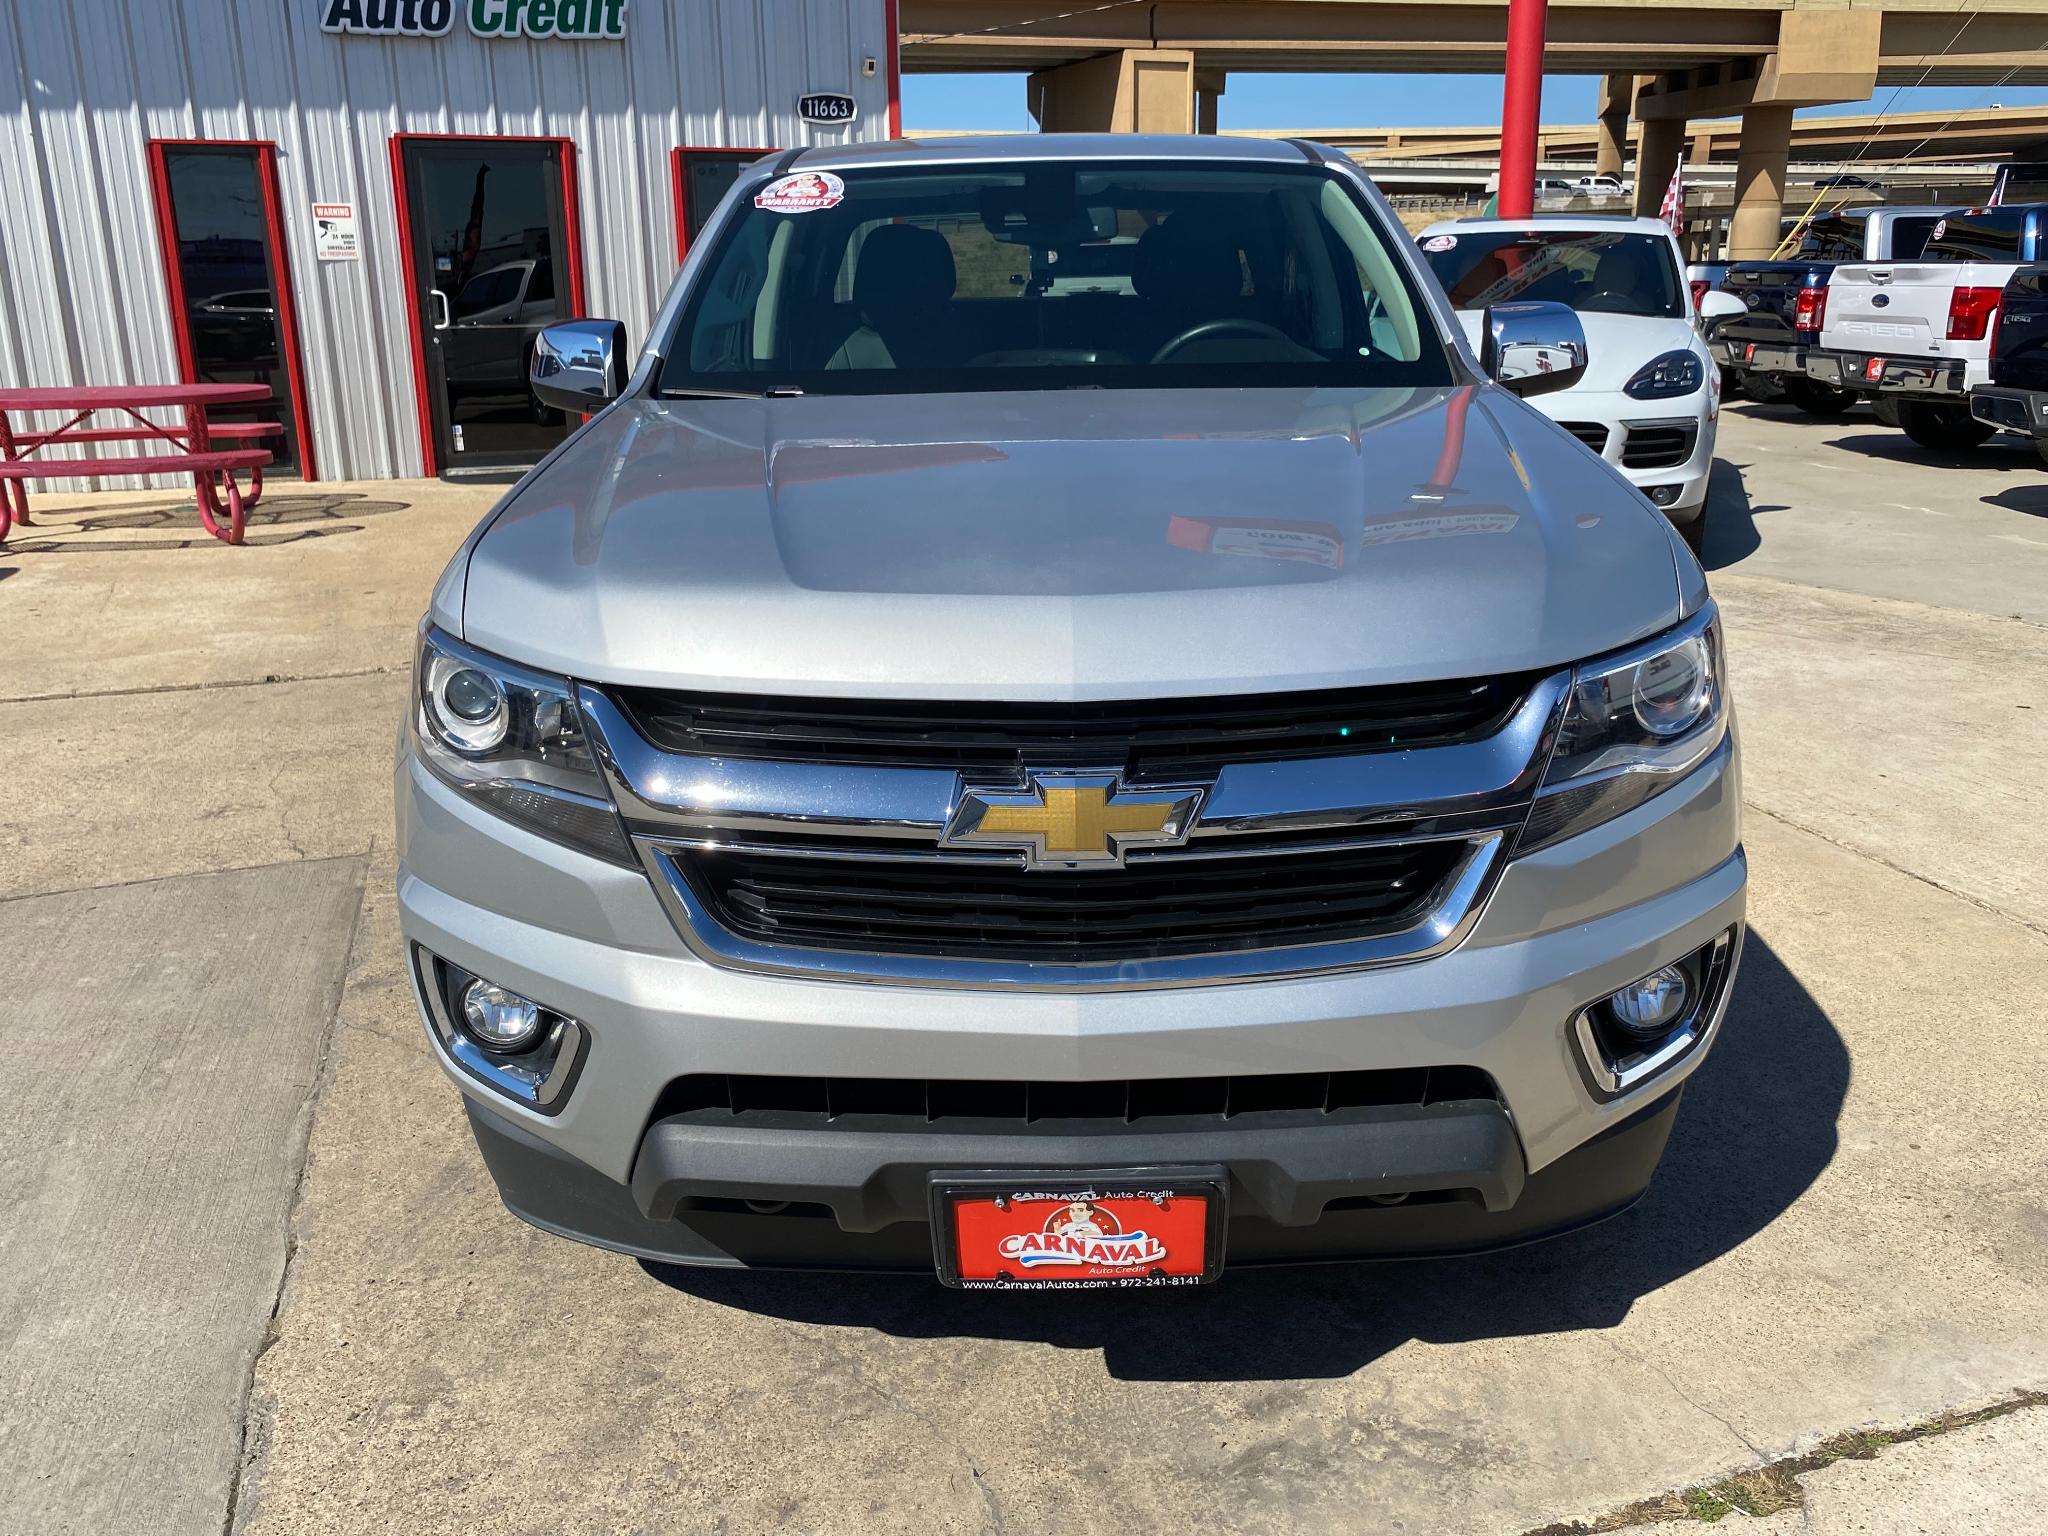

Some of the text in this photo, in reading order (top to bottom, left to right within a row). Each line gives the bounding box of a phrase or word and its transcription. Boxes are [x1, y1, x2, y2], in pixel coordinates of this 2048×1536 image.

[324, 0, 623, 35] Auto Credit
[807, 99, 848, 117] 11663
[761, 198, 832, 206] WARRANTY
[316, 207, 350, 217] WARNING
[1011, 1189, 1175, 1201] CARNAVAL Auto Credit
[1000, 1232, 1165, 1264] CARNAVAL
[1088, 1265, 1147, 1275] Auto Credit
[962, 1276, 1200, 1290] www.CarnavalAutos.com 972-241-8141
